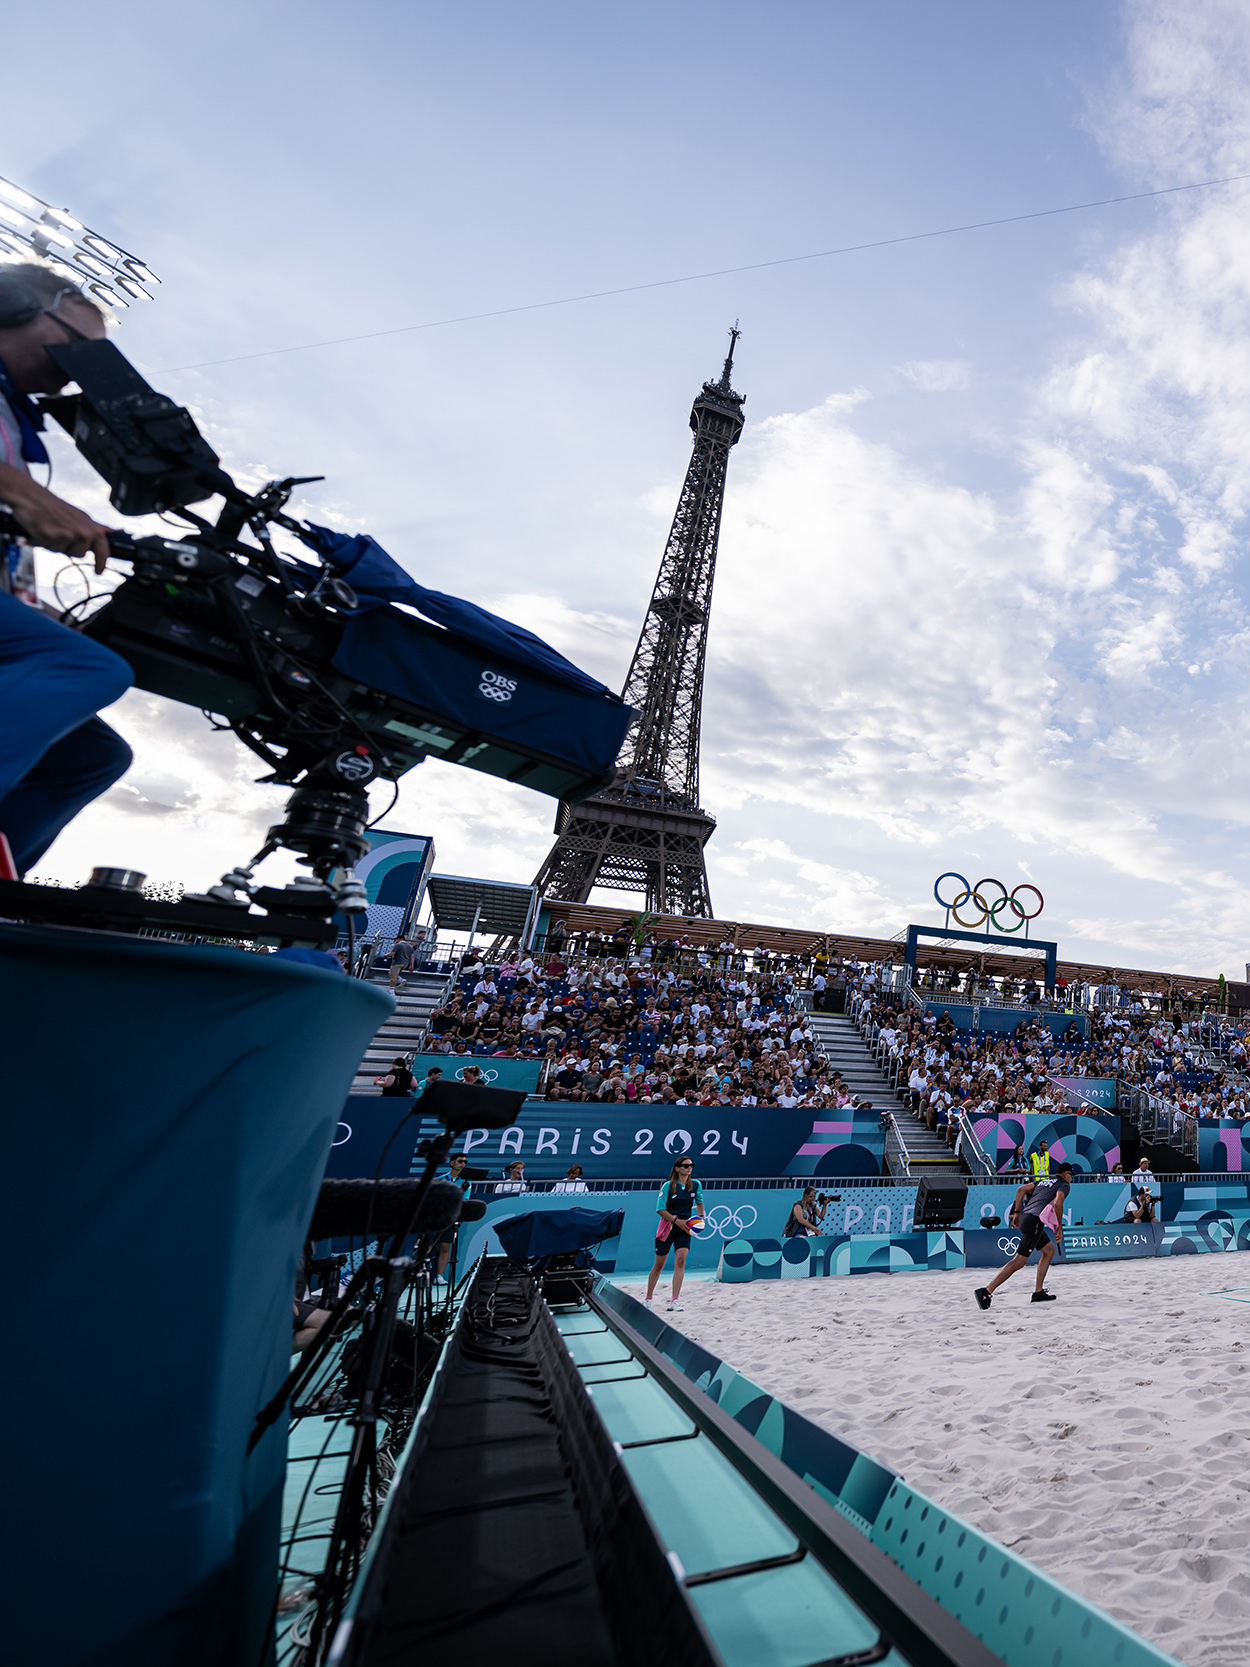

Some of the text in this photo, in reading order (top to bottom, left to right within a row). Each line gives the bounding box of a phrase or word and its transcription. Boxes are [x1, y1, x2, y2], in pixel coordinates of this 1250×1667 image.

[481, 670, 518, 692] OBS
[1085, 1089, 1110, 1098] 2024
[462, 1127, 749, 1156] PARIS 2024
[1072, 1234, 1148, 1248] PARIS 2024
